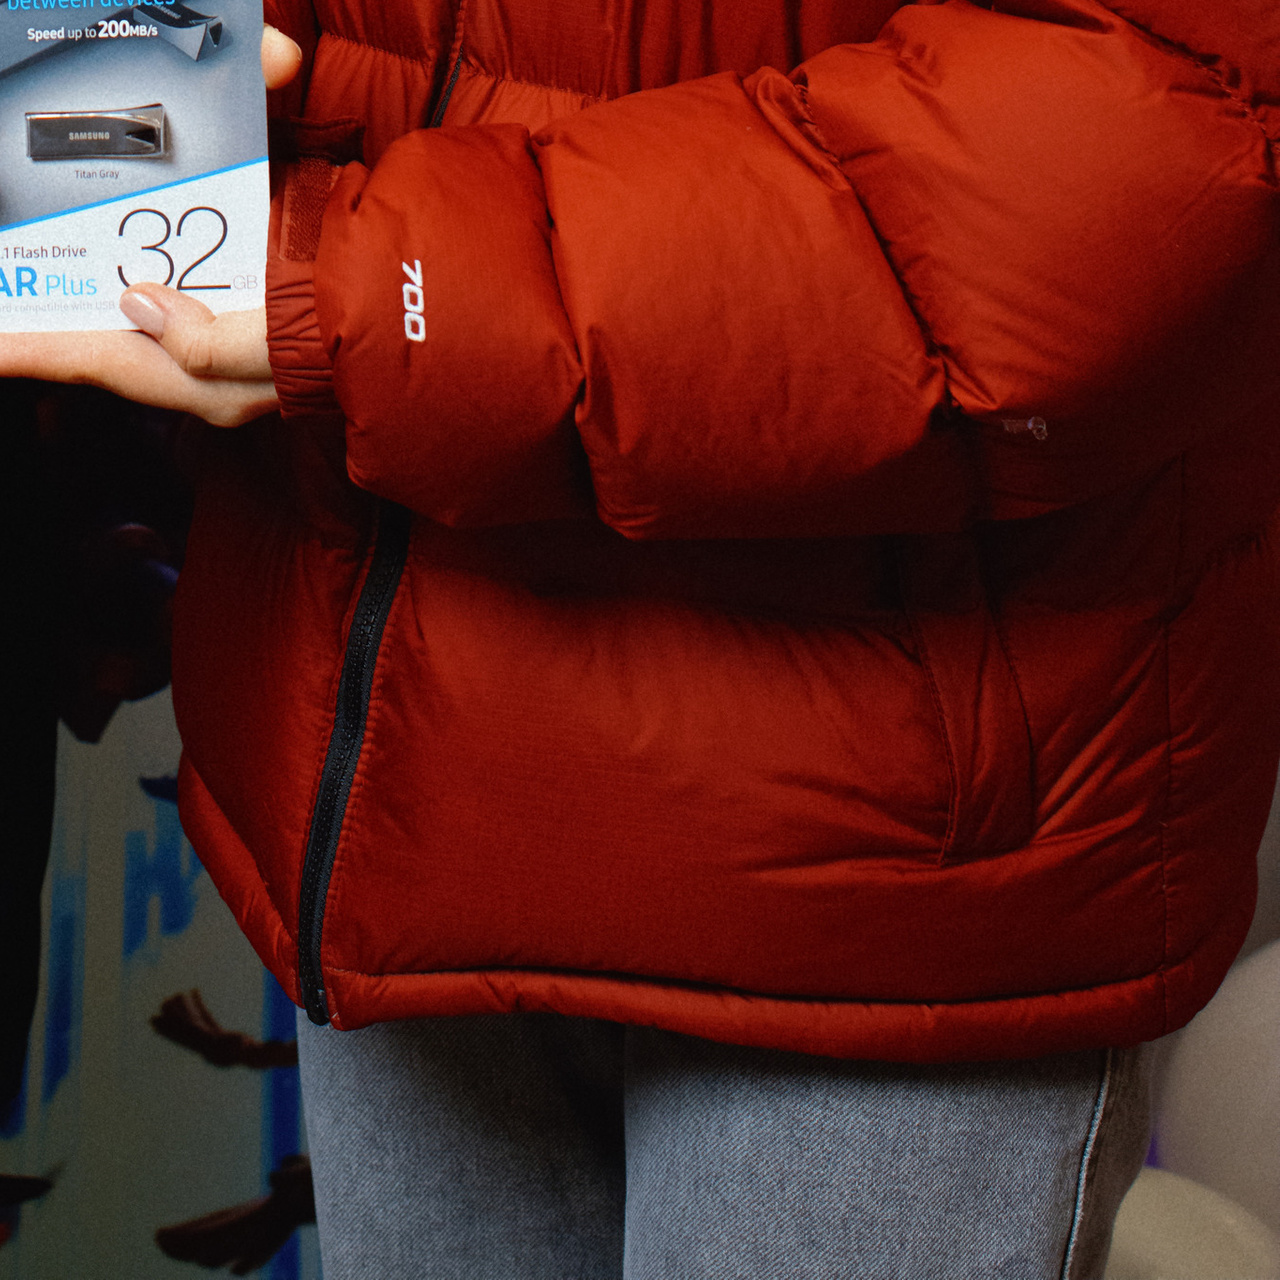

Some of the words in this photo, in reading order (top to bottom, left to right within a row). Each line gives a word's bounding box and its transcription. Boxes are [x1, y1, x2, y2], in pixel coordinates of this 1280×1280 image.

[27, 27, 65, 42] Speed
[67, 28, 82, 41] up
[85, 27, 97, 39] to
[69, 131, 110, 141] SAMSUNG
[75, 169, 97, 179] Titan
[99, 169, 120, 180] Gray
[13, 246, 48, 259] Flash
[52, 245, 87, 258] Drive
[46, 273, 97, 296] Plus
[15, 302, 69, 315] compatible
[71, 301, 93, 312] with
[95, 300, 116, 310] USB
[402, 259, 426, 342] 700
